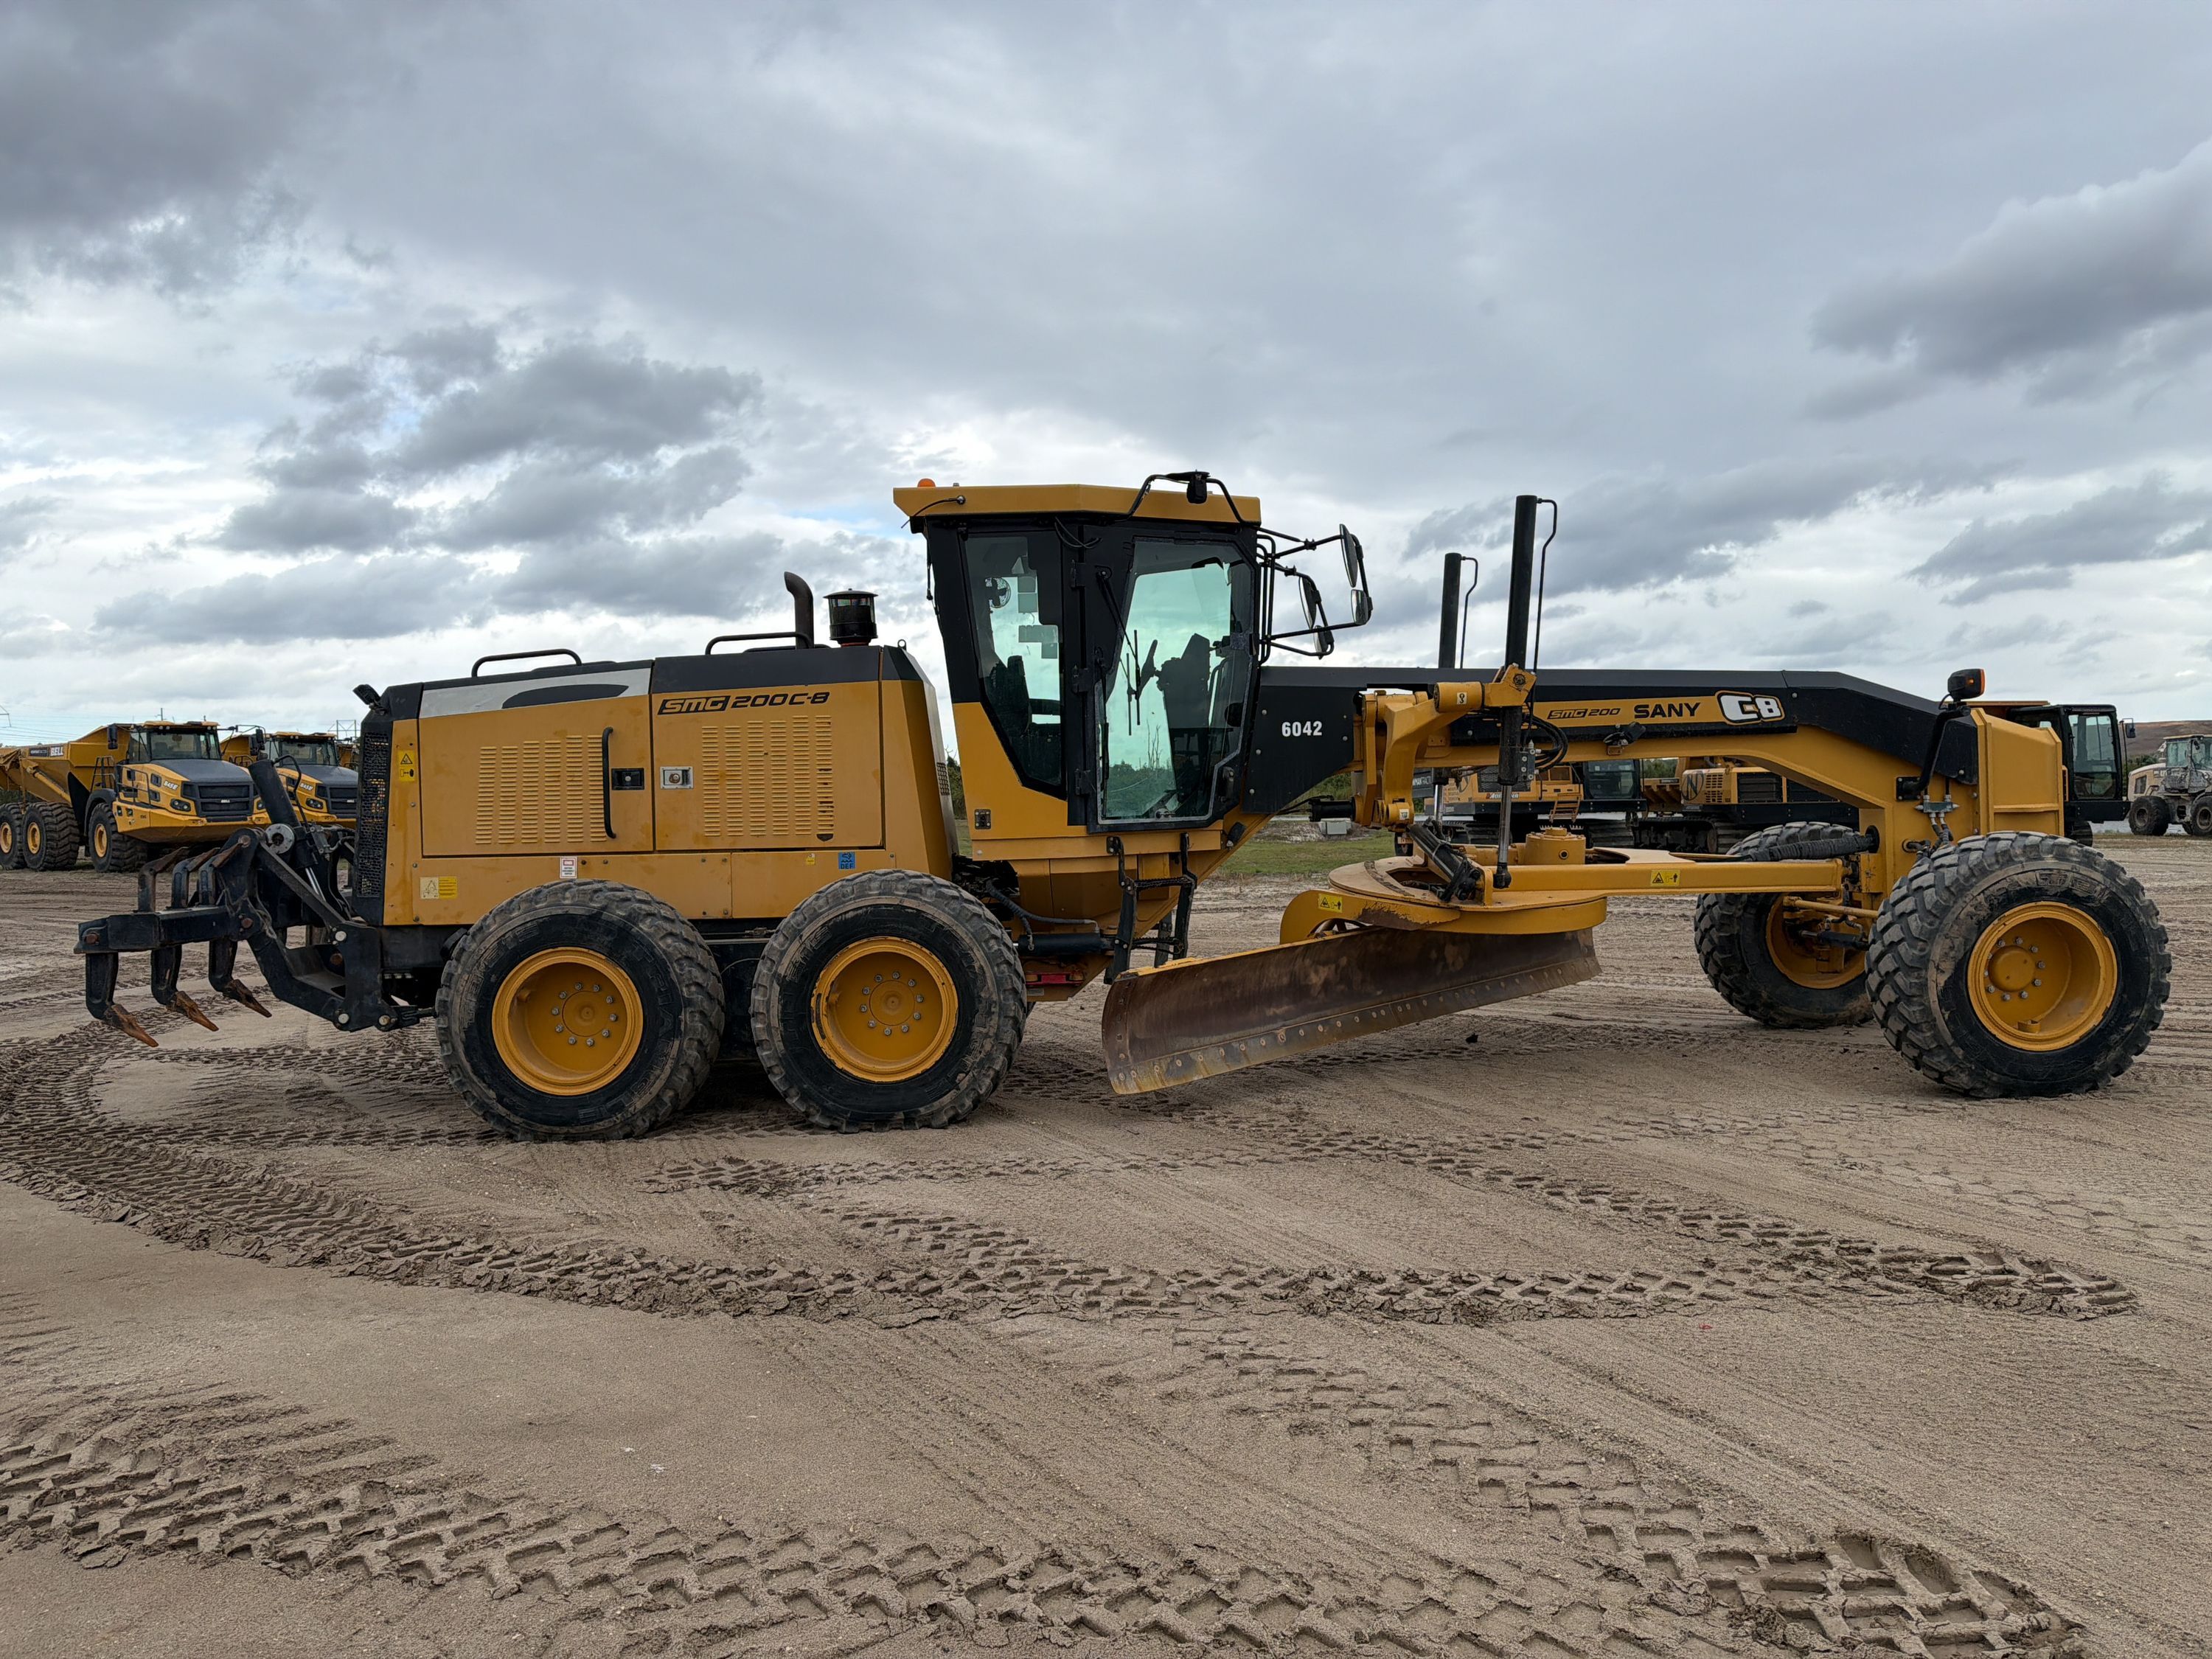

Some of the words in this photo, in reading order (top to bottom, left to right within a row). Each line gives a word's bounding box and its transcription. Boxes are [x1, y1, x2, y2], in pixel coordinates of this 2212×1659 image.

[658, 695, 731, 714] SMG
[1634, 703, 1700, 718] SANY
[1548, 709, 1587, 719] SMG
[1589, 708, 1621, 716] 200
[1281, 720, 1322, 737] 6042
[50, 746, 63, 757] BELL
